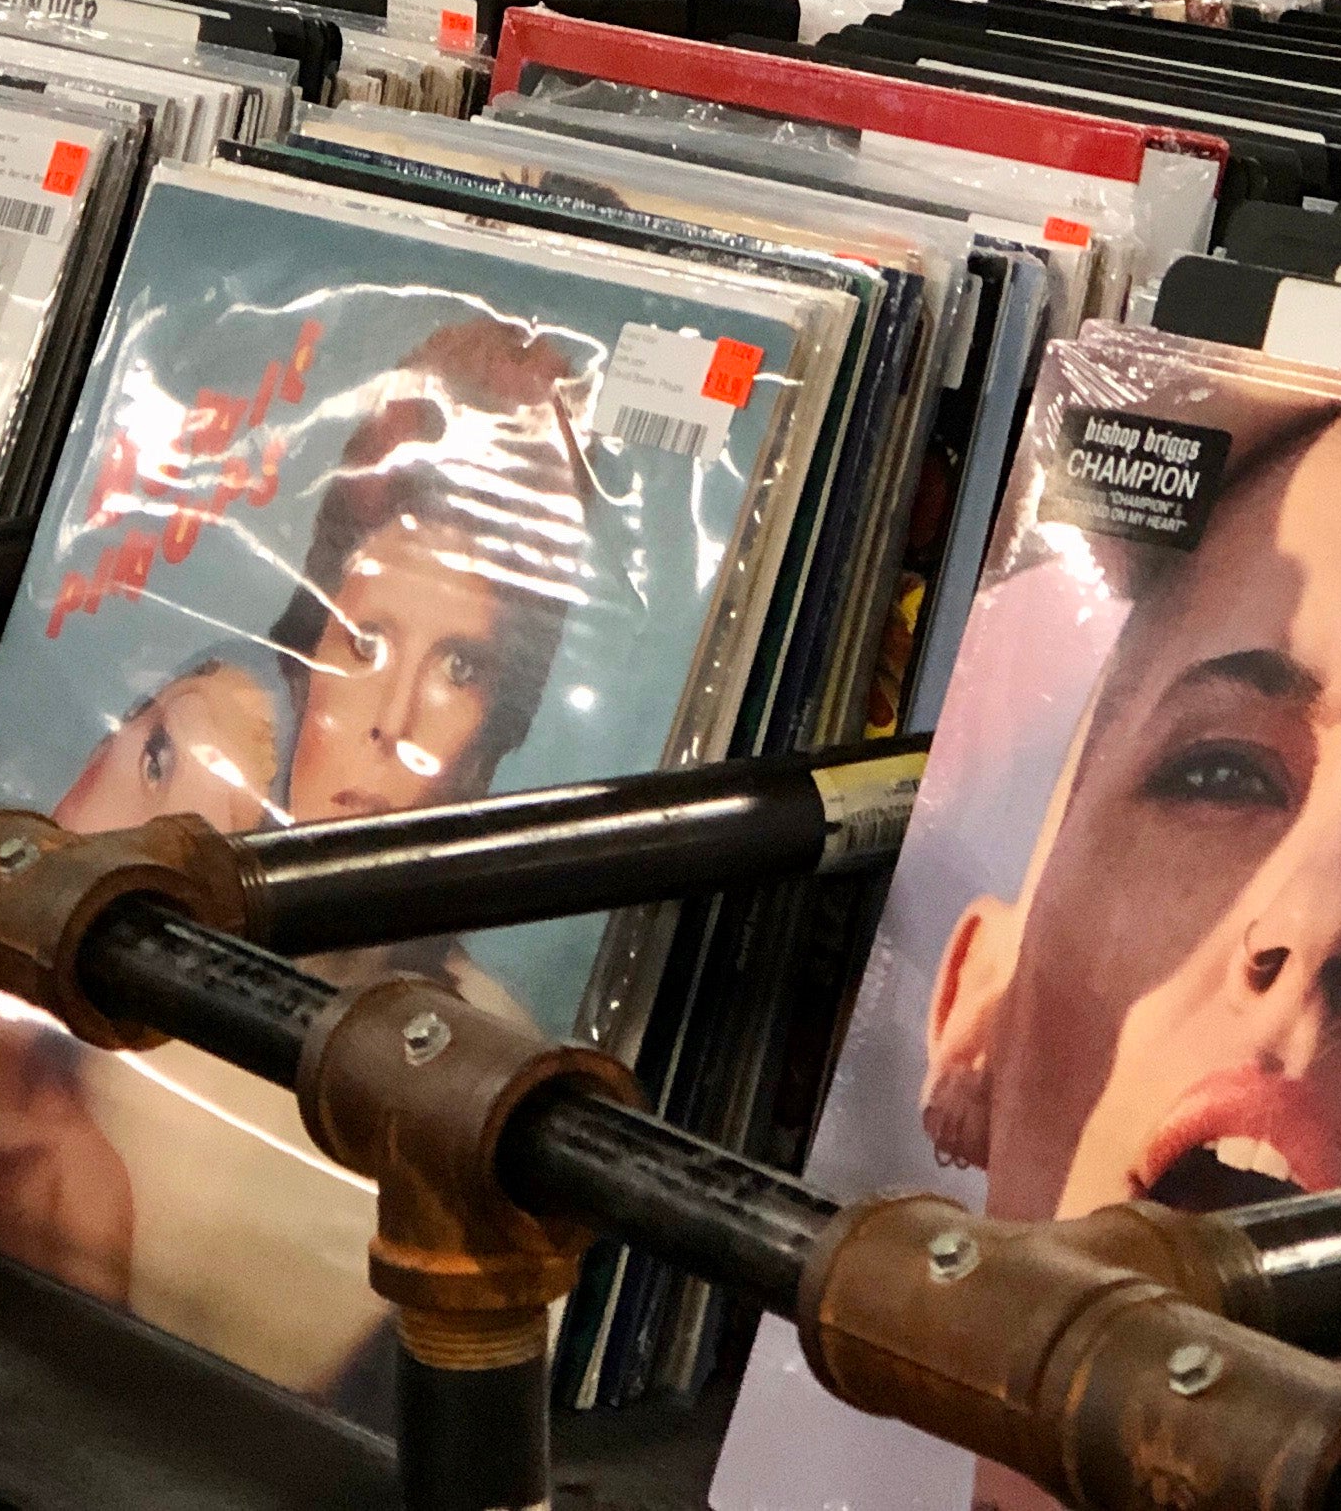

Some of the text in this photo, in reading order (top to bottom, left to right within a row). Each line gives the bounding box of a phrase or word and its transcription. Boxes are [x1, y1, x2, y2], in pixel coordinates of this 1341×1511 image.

[1084, 415, 1202, 466] bishop briggs
[1066, 448, 1201, 500] CHAMPION
